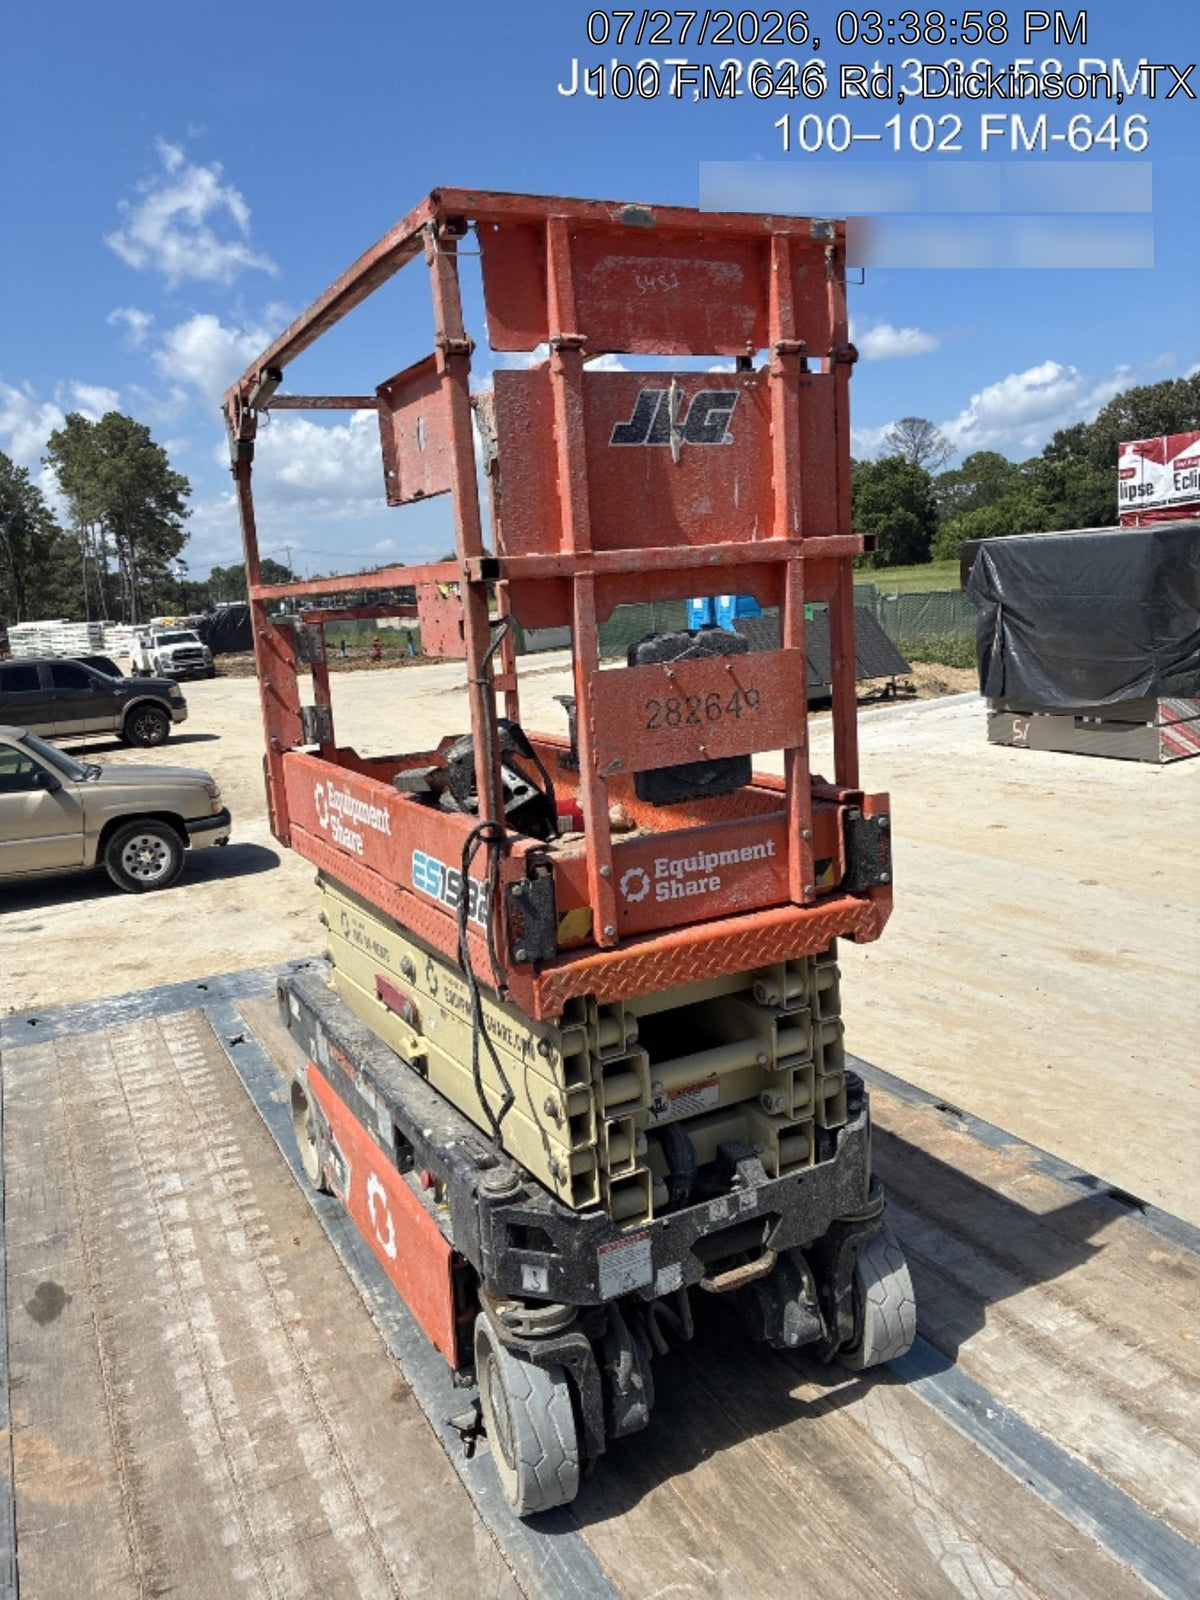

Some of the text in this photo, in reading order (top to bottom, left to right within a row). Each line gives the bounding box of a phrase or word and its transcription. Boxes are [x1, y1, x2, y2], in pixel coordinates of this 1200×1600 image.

[608, 389, 740, 446] JLG
[1173, 468, 1200, 492] Ecli
[326, 780, 392, 837] Equipment
[330, 814, 364, 856] Share
[653, 839, 776, 880] Equipment
[655, 874, 721, 903] Share
